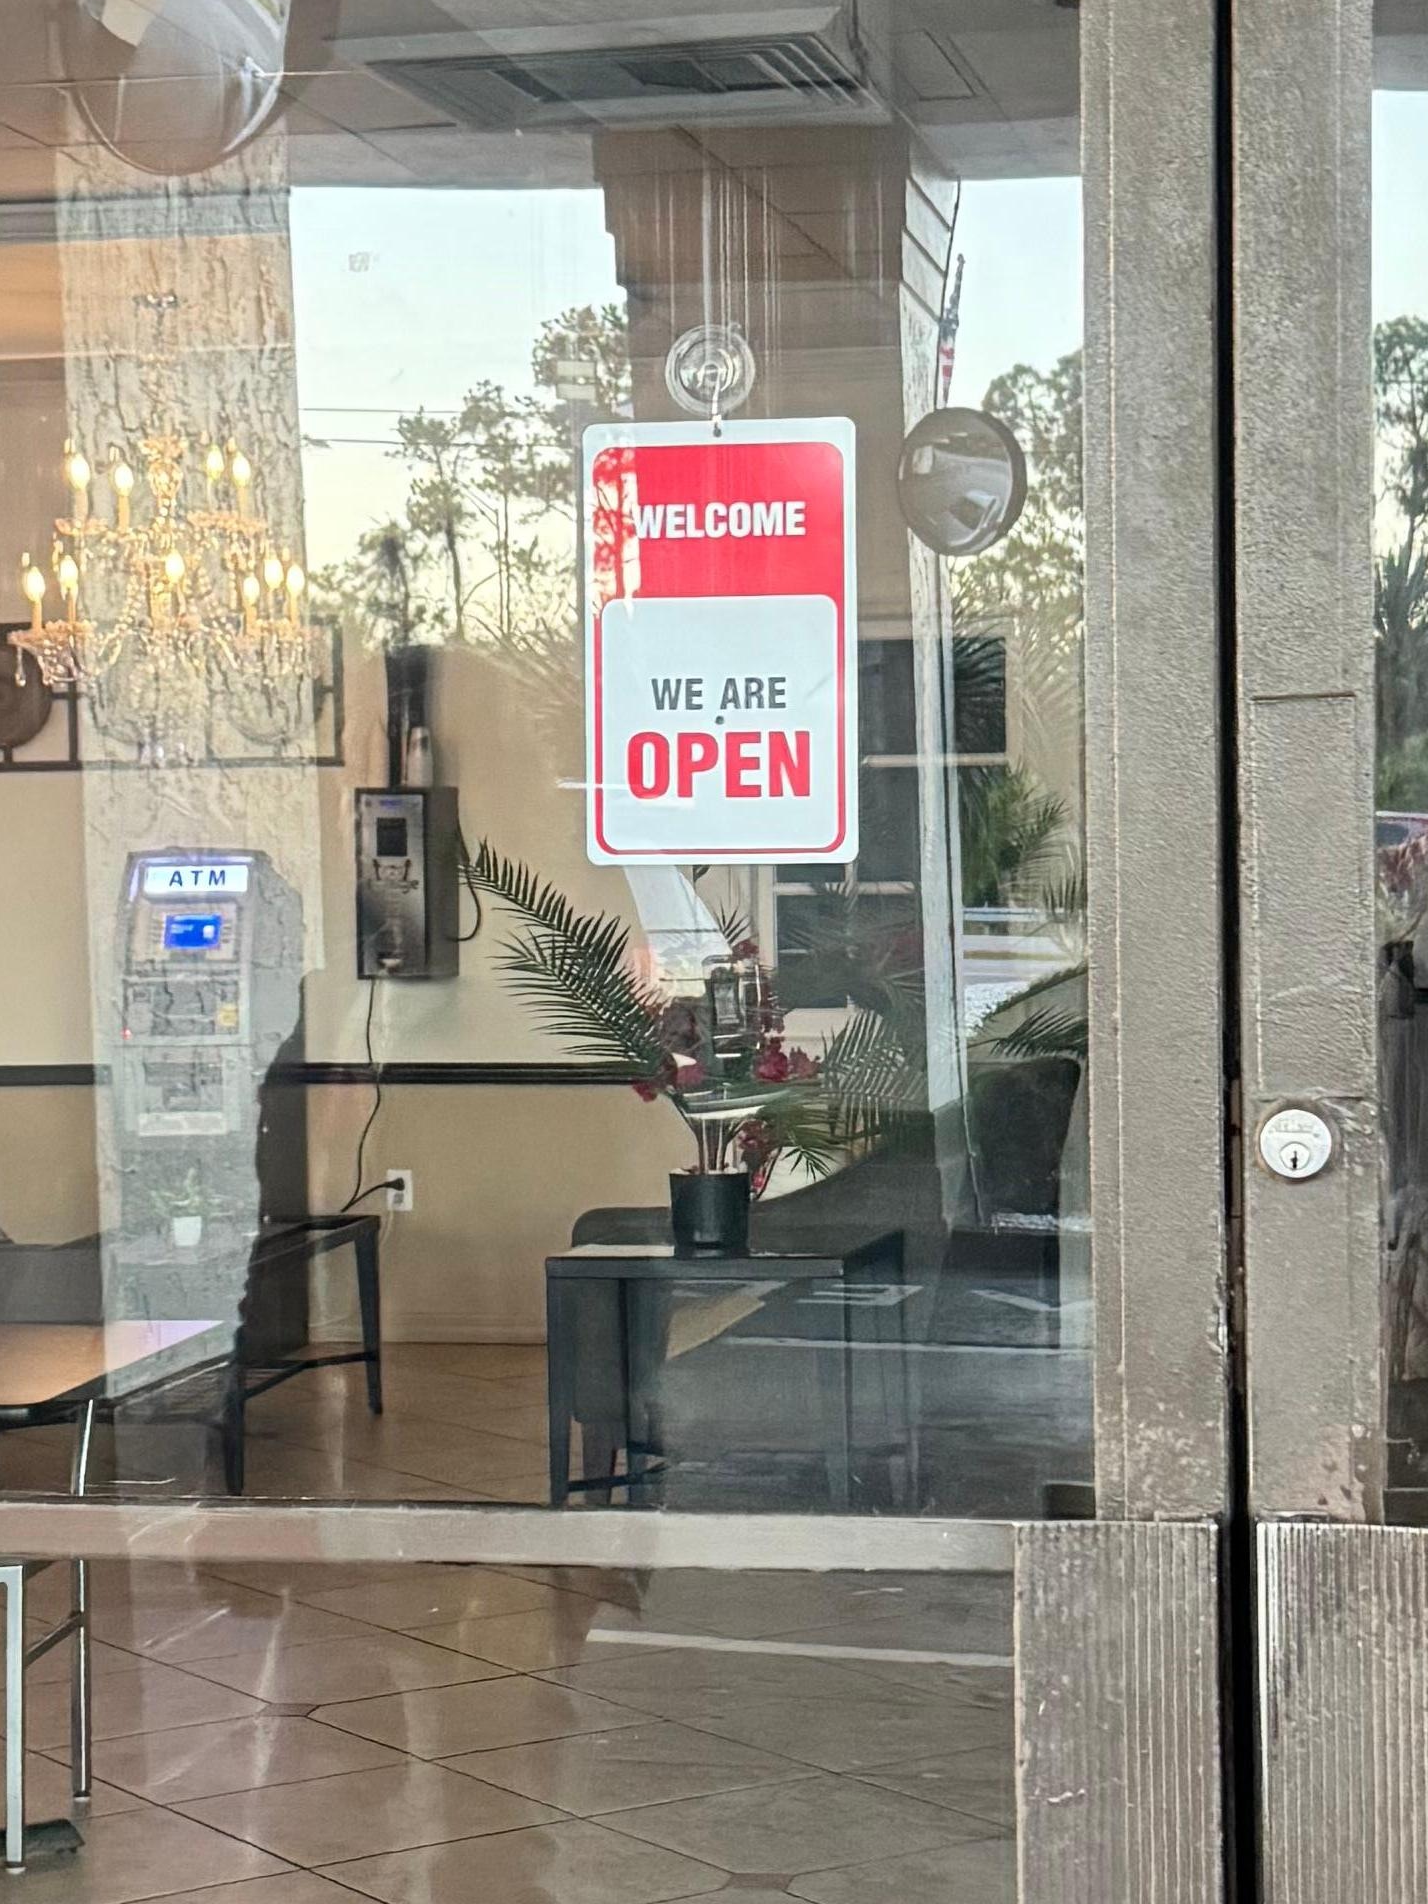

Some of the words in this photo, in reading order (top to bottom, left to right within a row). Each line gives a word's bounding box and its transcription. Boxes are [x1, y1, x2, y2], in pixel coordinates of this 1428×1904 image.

[634, 500, 806, 539] WELCOME
[651, 677, 703, 711] WE
[720, 676, 787, 710] ARE
[626, 729, 811, 800] OPEN
[169, 869, 227, 887] ATM
